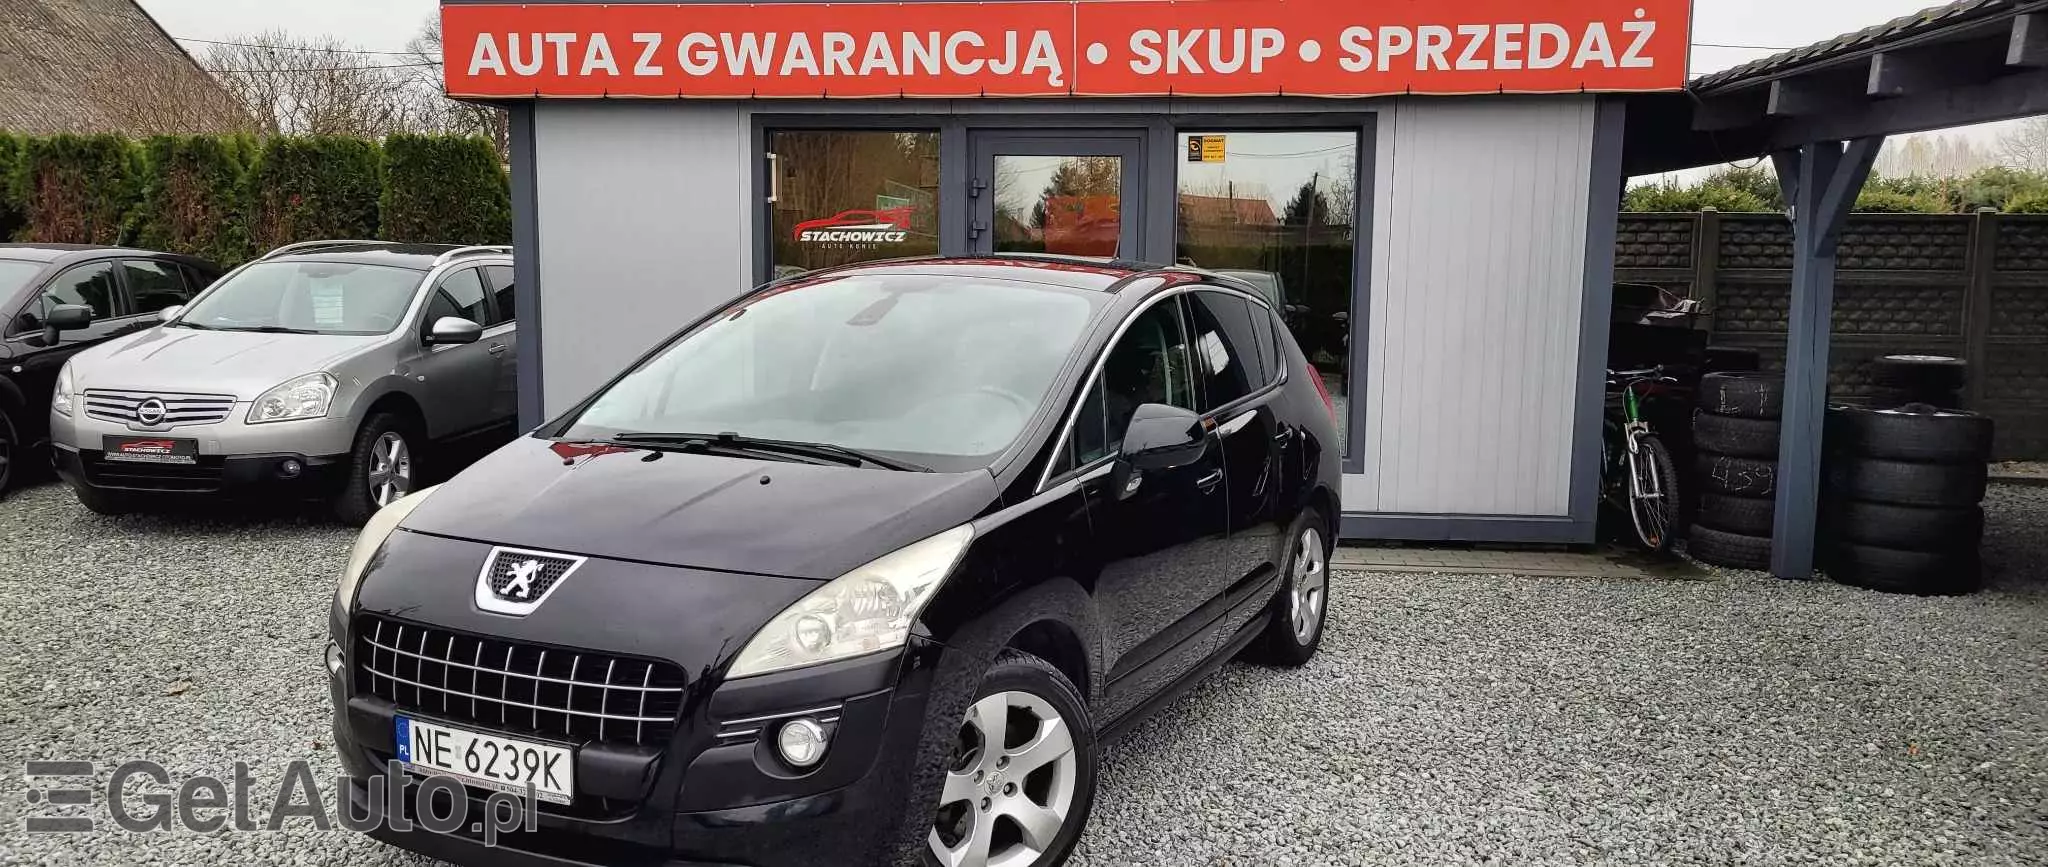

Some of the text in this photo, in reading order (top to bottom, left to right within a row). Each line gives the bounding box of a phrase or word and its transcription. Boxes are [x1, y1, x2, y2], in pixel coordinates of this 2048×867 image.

[467, 7, 1657, 87] AUTA Z GWARANCJĄ SKUP SPRZEDAŻ
[800, 231, 906, 242] STACHOWICZ
[399, 744, 410, 756] PL
[415, 725, 452, 768] NE
[465, 738, 562, 790] 6239K
